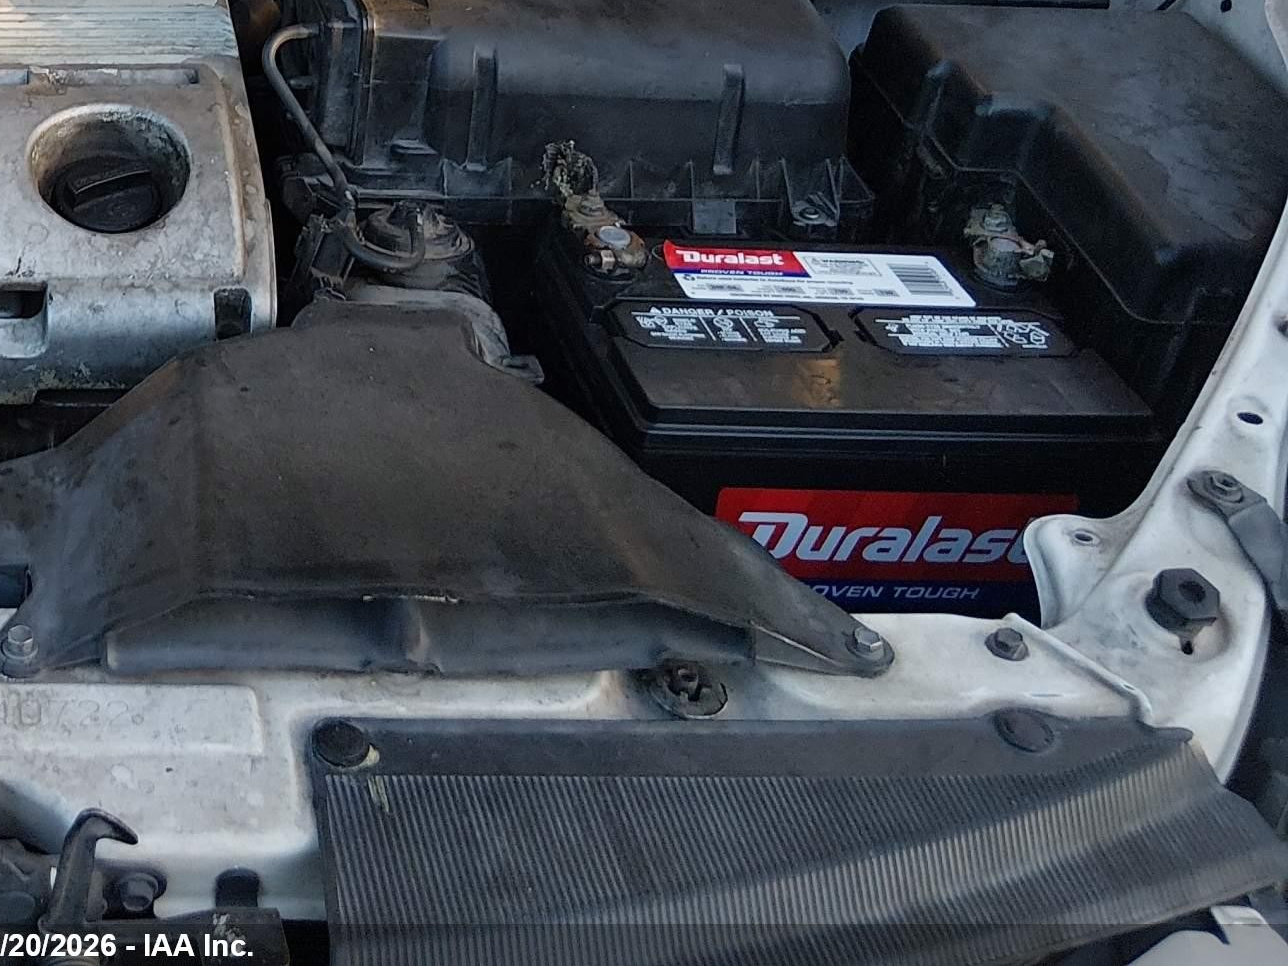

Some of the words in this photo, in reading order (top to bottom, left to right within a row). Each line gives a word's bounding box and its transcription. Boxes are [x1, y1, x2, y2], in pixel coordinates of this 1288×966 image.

[675, 249, 785, 266] Duralast
[662, 308, 715, 316] DANGER
[725, 309, 775, 317] POISON
[893, 586, 981, 599] TOUGH
